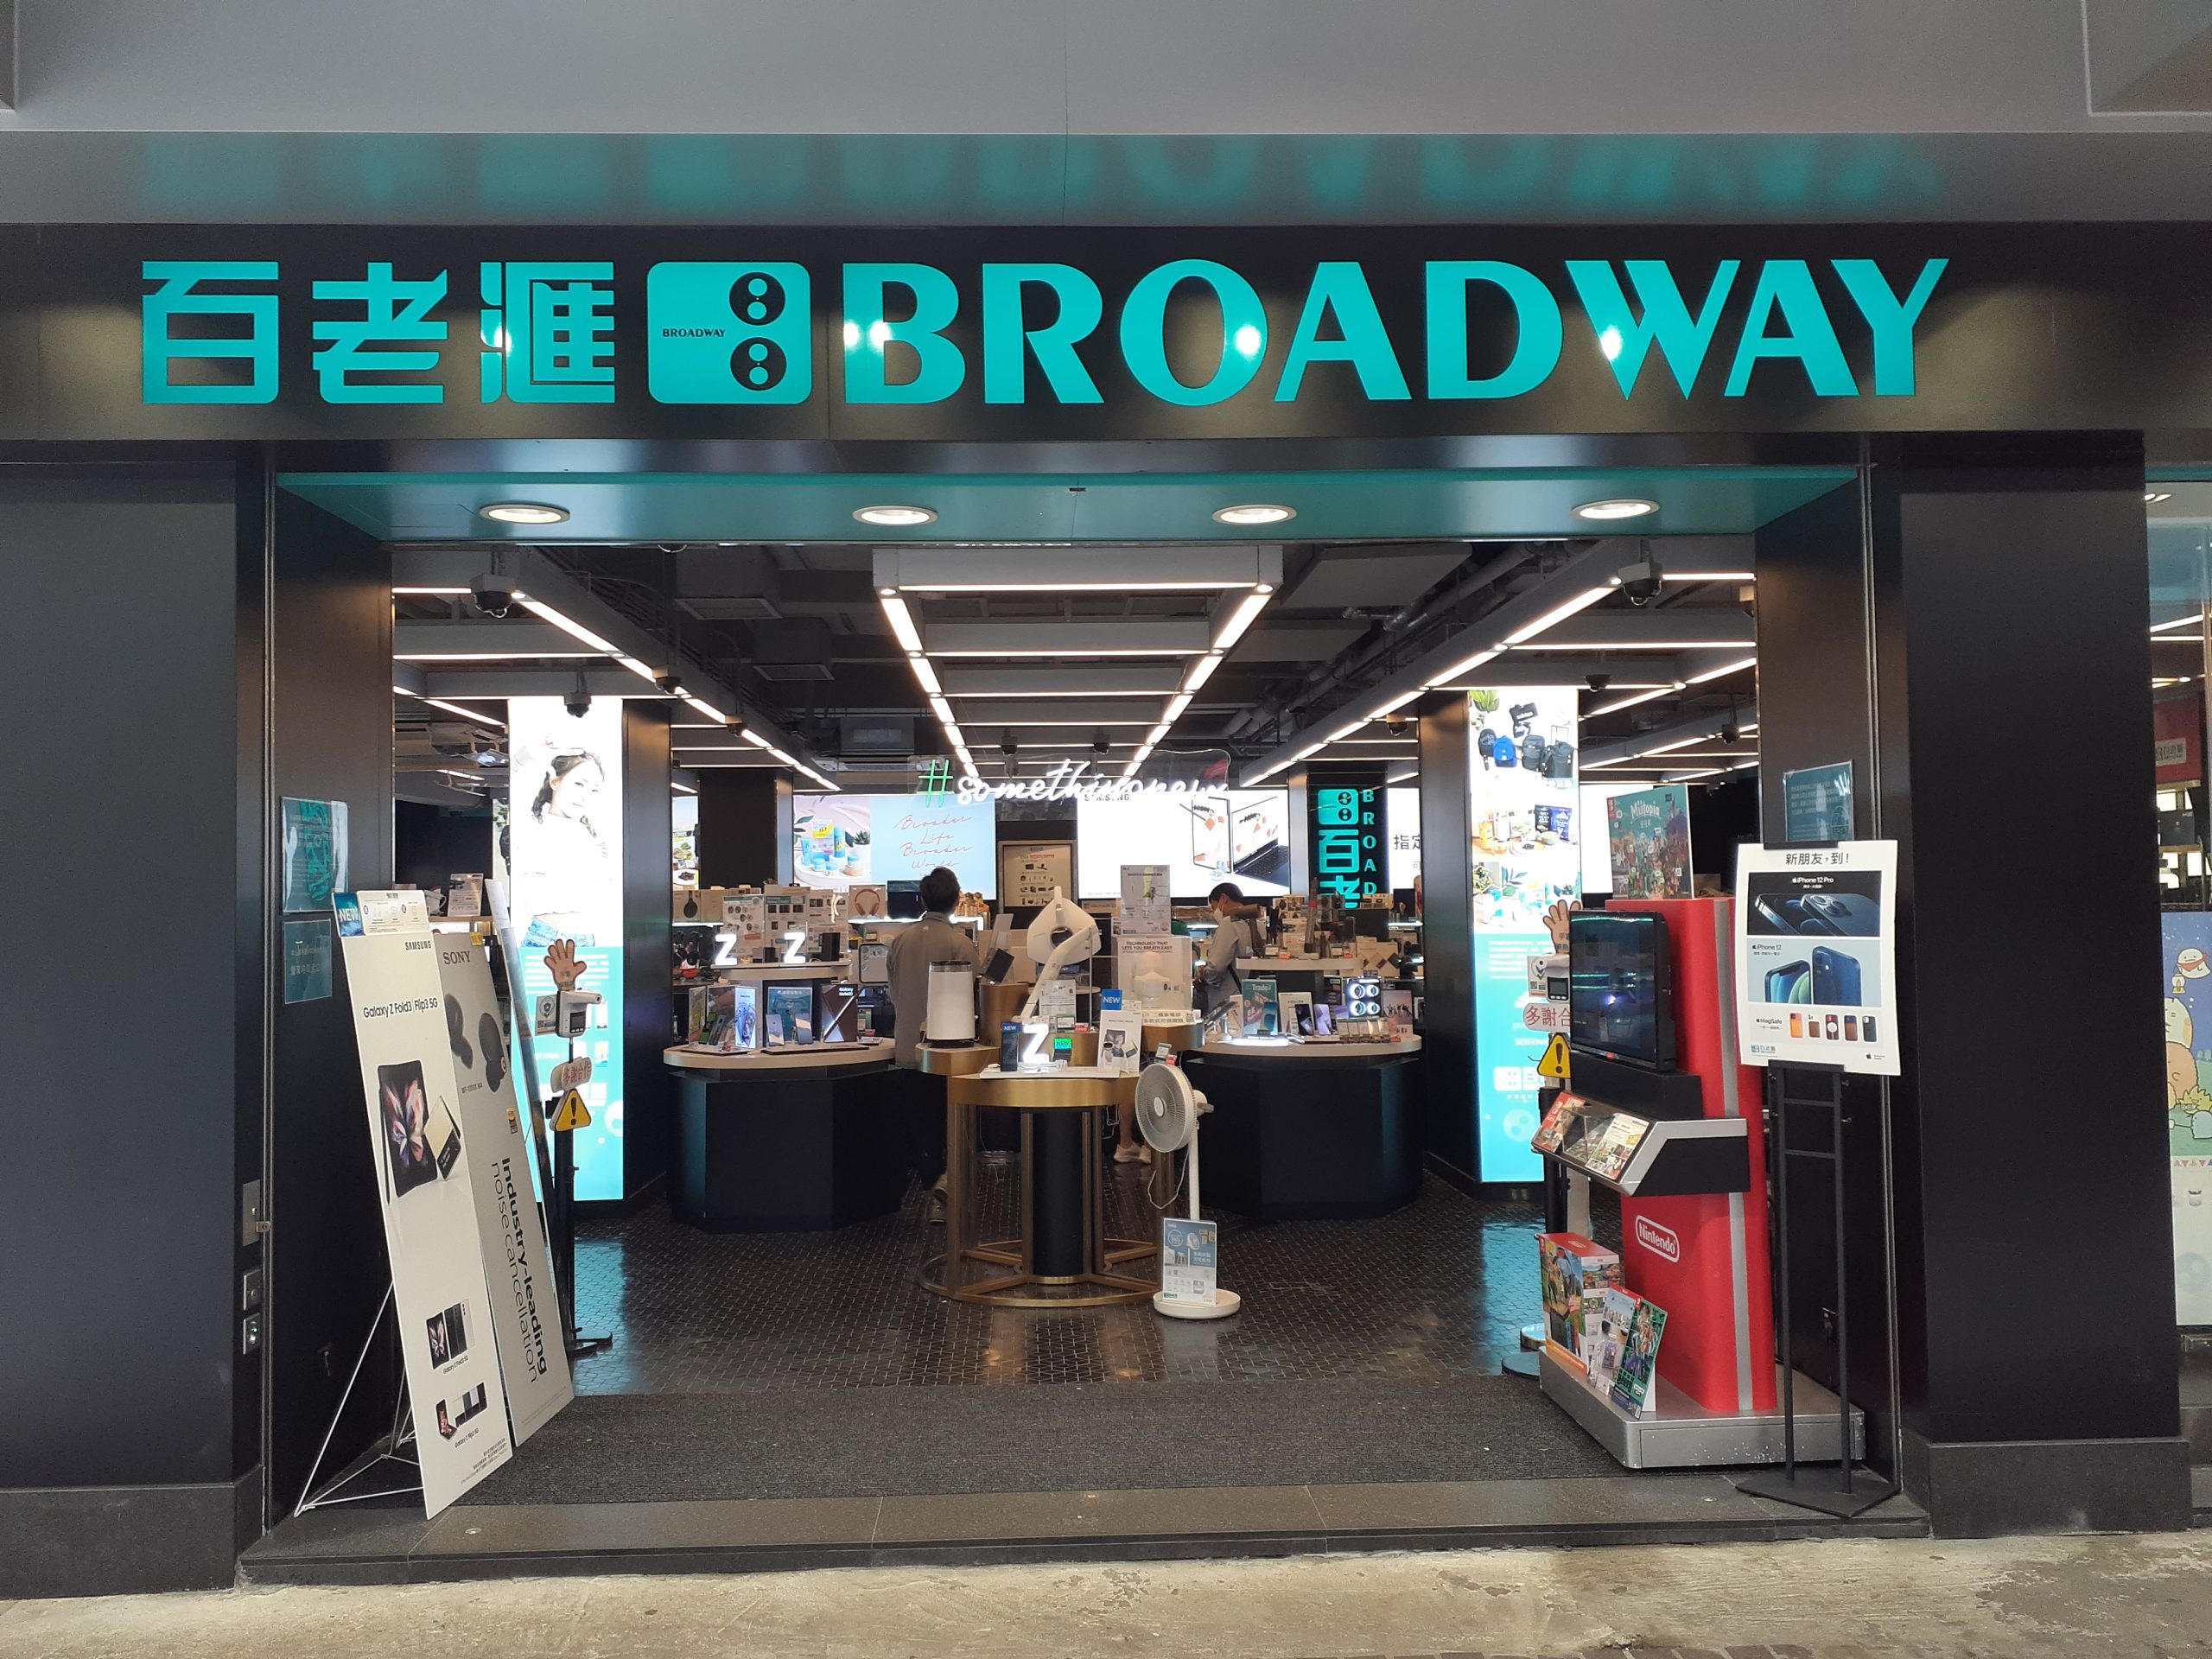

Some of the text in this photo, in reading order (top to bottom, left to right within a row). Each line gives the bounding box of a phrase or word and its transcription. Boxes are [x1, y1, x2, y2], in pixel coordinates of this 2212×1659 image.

[662, 328, 726, 337] BROADWAY
[842, 258, 1949, 406] BROADWAY
[1630, 799, 1661, 819] Miitopia
[337, 908, 359, 922] NEW
[404, 940, 431, 950] SAMSUNG
[442, 950, 471, 965] SONY
[715, 933, 737, 965] Z
[784, 931, 806, 964] Z
[363, 997, 438, 1019] Galaxy Z Fold3 Flip3 5G
[1022, 1023, 1050, 1064] Z
[1638, 1222, 1676, 1255] Nintendo
[491, 1162, 538, 1383] noise cancellation
[502, 1157, 547, 1376] Industry-leading
